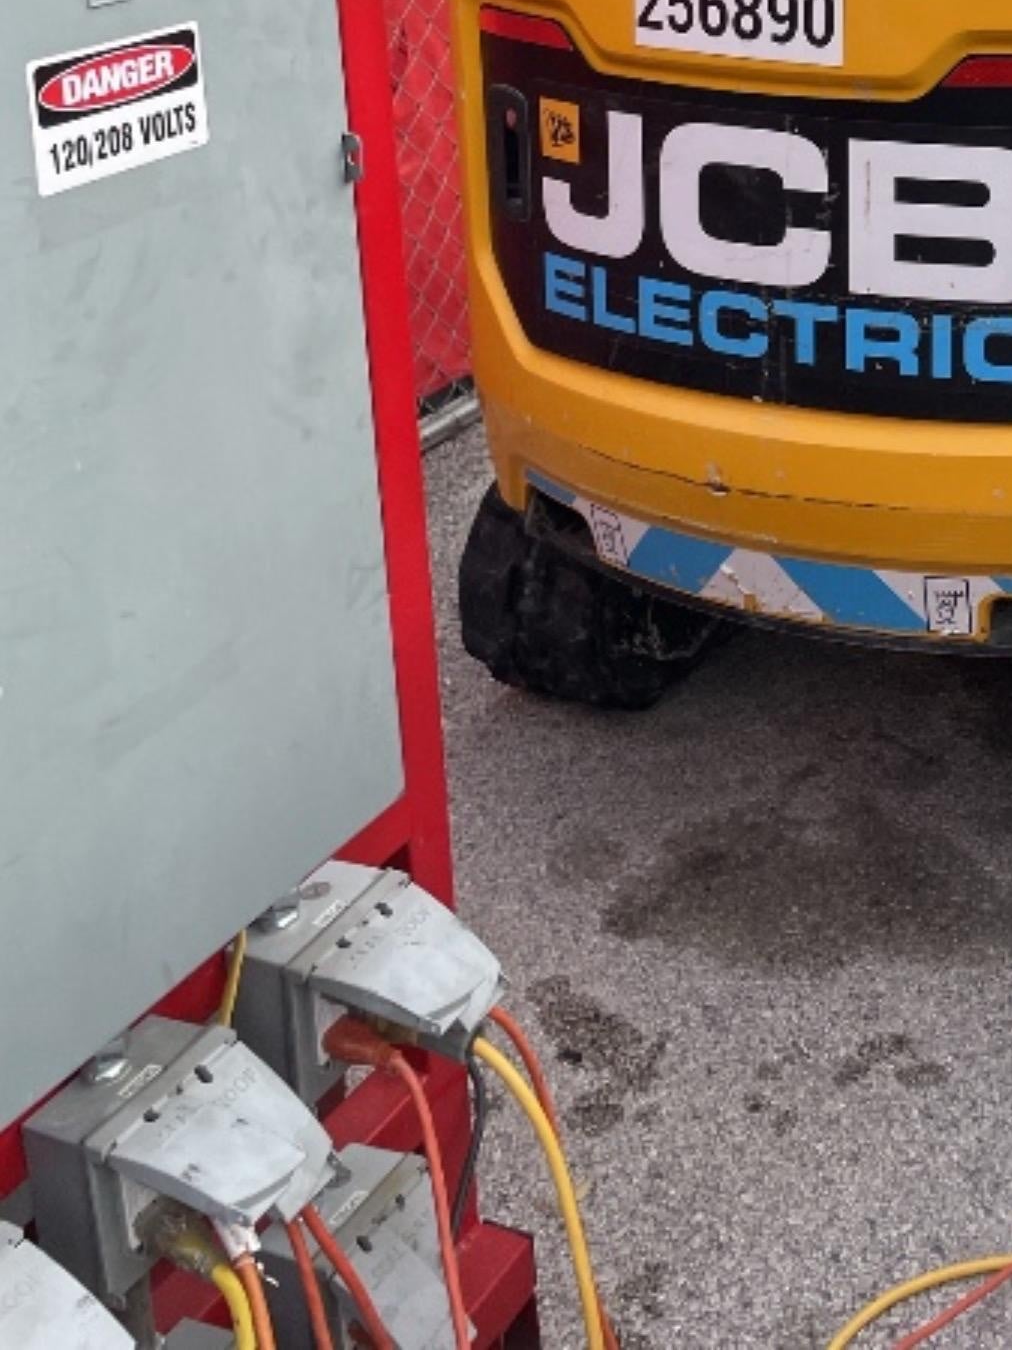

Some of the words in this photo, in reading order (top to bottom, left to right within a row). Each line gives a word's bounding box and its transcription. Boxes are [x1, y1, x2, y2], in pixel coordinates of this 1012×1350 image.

[61, 50, 174, 105] DANGER
[50, 122, 133, 175] 120/208
[138, 102, 195, 145] VOLTS
